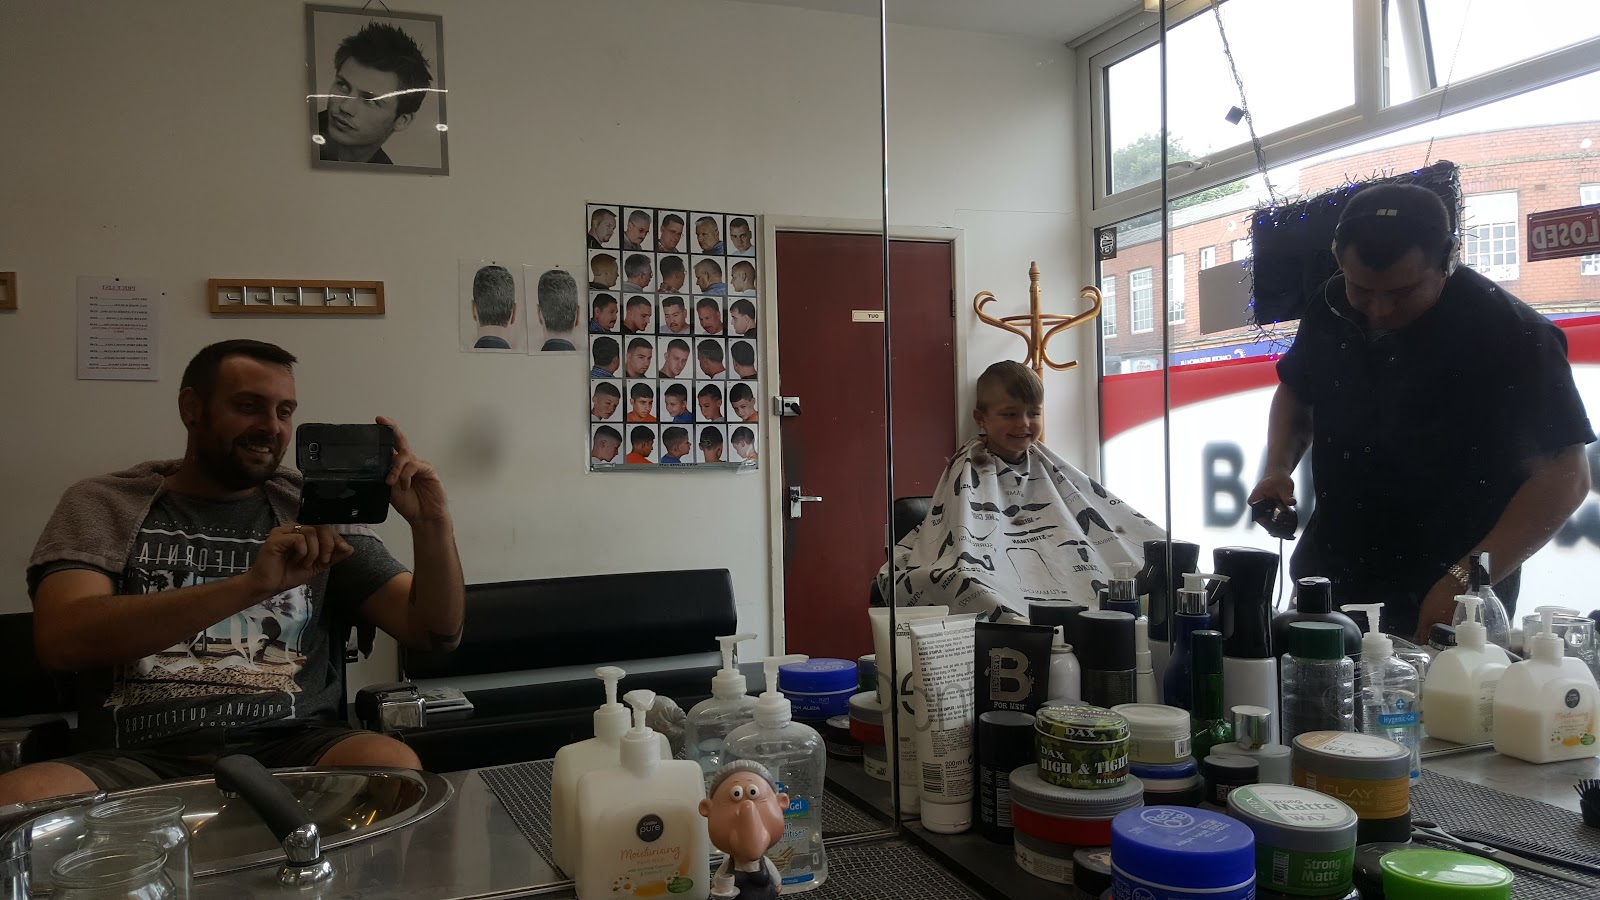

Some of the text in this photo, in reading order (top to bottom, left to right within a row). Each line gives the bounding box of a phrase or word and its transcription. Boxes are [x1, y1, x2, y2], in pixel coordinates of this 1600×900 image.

[993, 701, 1008, 709] FOR
[1064, 727, 1096, 738] DAX
[1041, 745, 1066, 760] DAX
[1041, 758, 1072, 774] HIGH
[1077, 763, 1090, 774] &
[1323, 784, 1374, 799] CLAY
[1273, 802, 1337, 812] Matte
[639, 823, 661, 835] pure
[782, 829, 805, 838] nitiser
[620, 845, 680, 861] Moisturising
[1304, 858, 1341, 870] Strong
[1301, 869, 1340, 882] Matte
